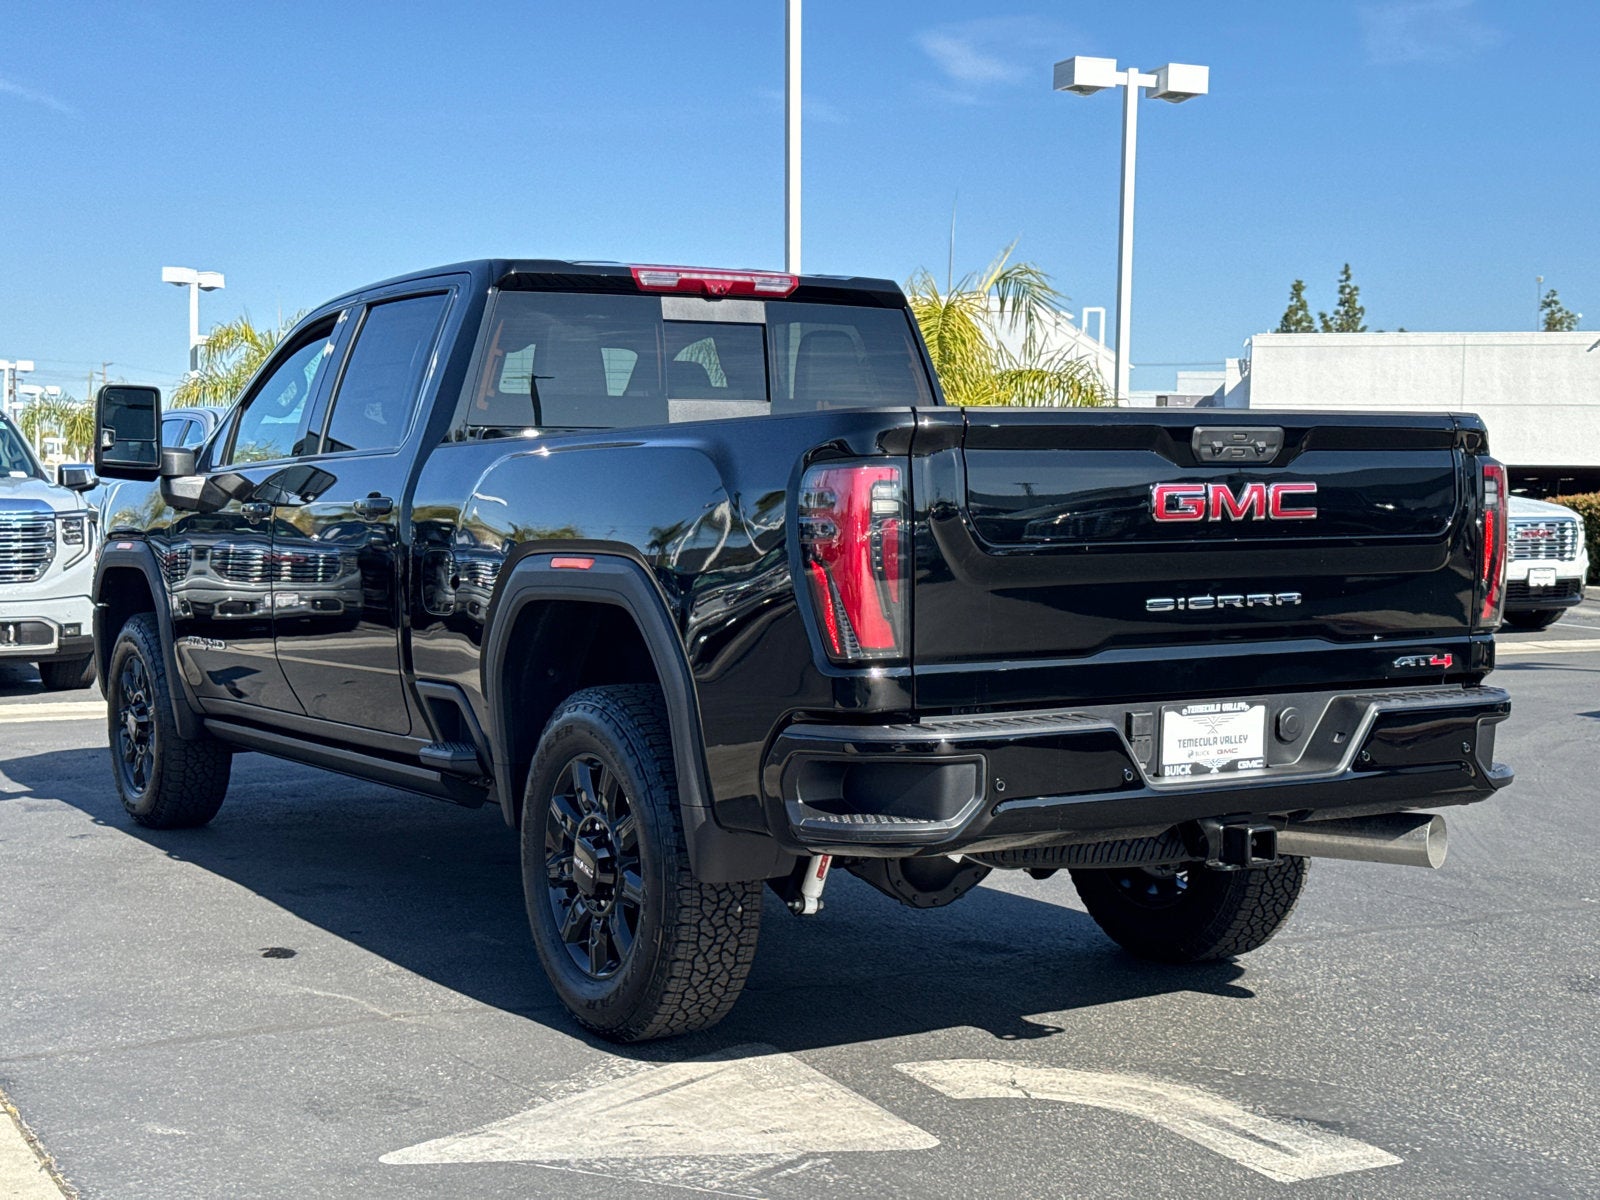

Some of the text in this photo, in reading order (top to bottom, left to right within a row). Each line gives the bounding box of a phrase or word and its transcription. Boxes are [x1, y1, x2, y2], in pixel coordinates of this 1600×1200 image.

[1151, 482, 1318, 522] GMC
[1145, 592, 1302, 612] SIERRA
[1393, 653, 1453, 669] AT4
[1178, 734, 1248, 749] TEMECULA VALLEY
[1165, 760, 1264, 776] BUICK GMC
